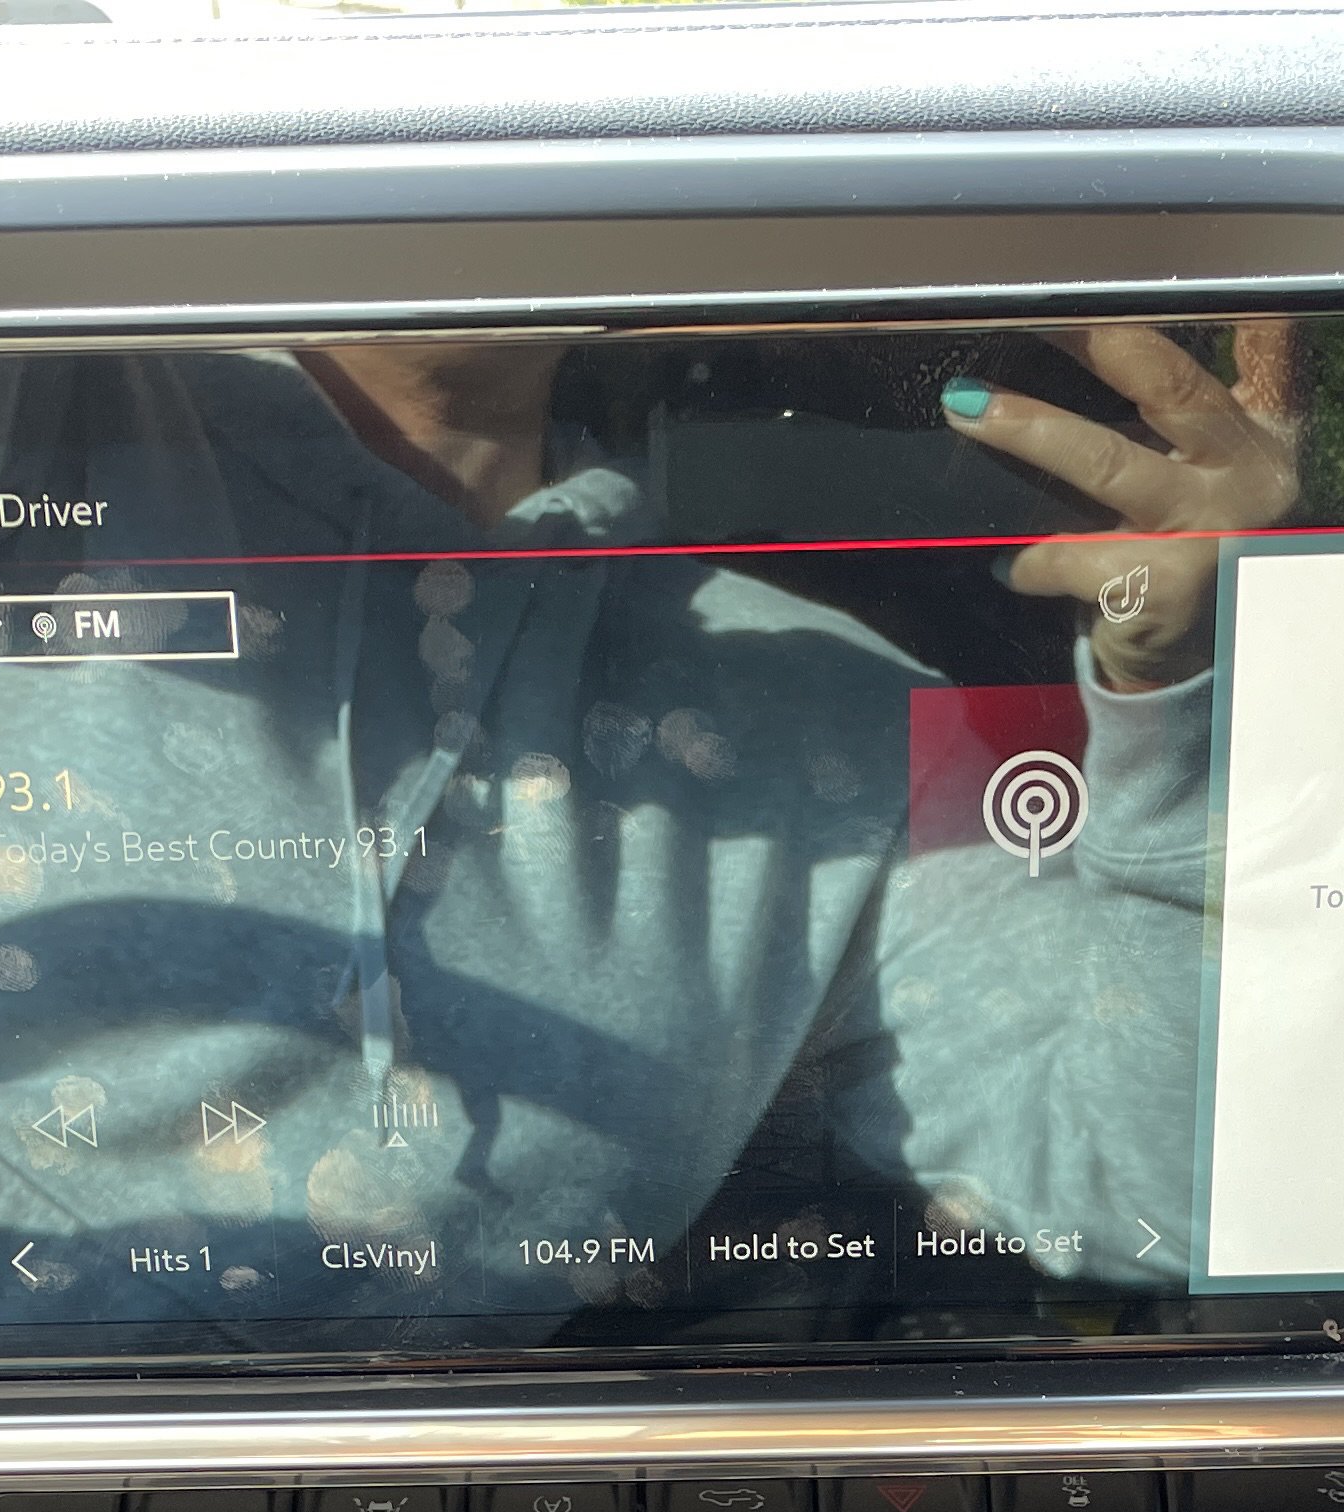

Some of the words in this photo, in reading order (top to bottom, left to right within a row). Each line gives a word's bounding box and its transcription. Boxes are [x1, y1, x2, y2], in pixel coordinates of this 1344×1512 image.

[74, 610, 120, 639] FM
[122, 831, 198, 864] Best
[209, 829, 346, 868] Country
[356, 825, 427, 858] 93.1
[1310, 884, 1344, 909] To
[518, 1238, 601, 1265] 104.9
[610, 1237, 656, 1263] FM
[709, 1232, 778, 1261] Hold
[787, 1238, 818, 1259] to
[827, 1234, 875, 1259] Set
[916, 1227, 985, 1256] Hold
[994, 1233, 1026, 1254] to
[1035, 1229, 1082, 1254] Set
[131, 1246, 190, 1272] Hits
[199, 1246, 212, 1271] 1
[321, 1240, 437, 1274] ClsVinyl
